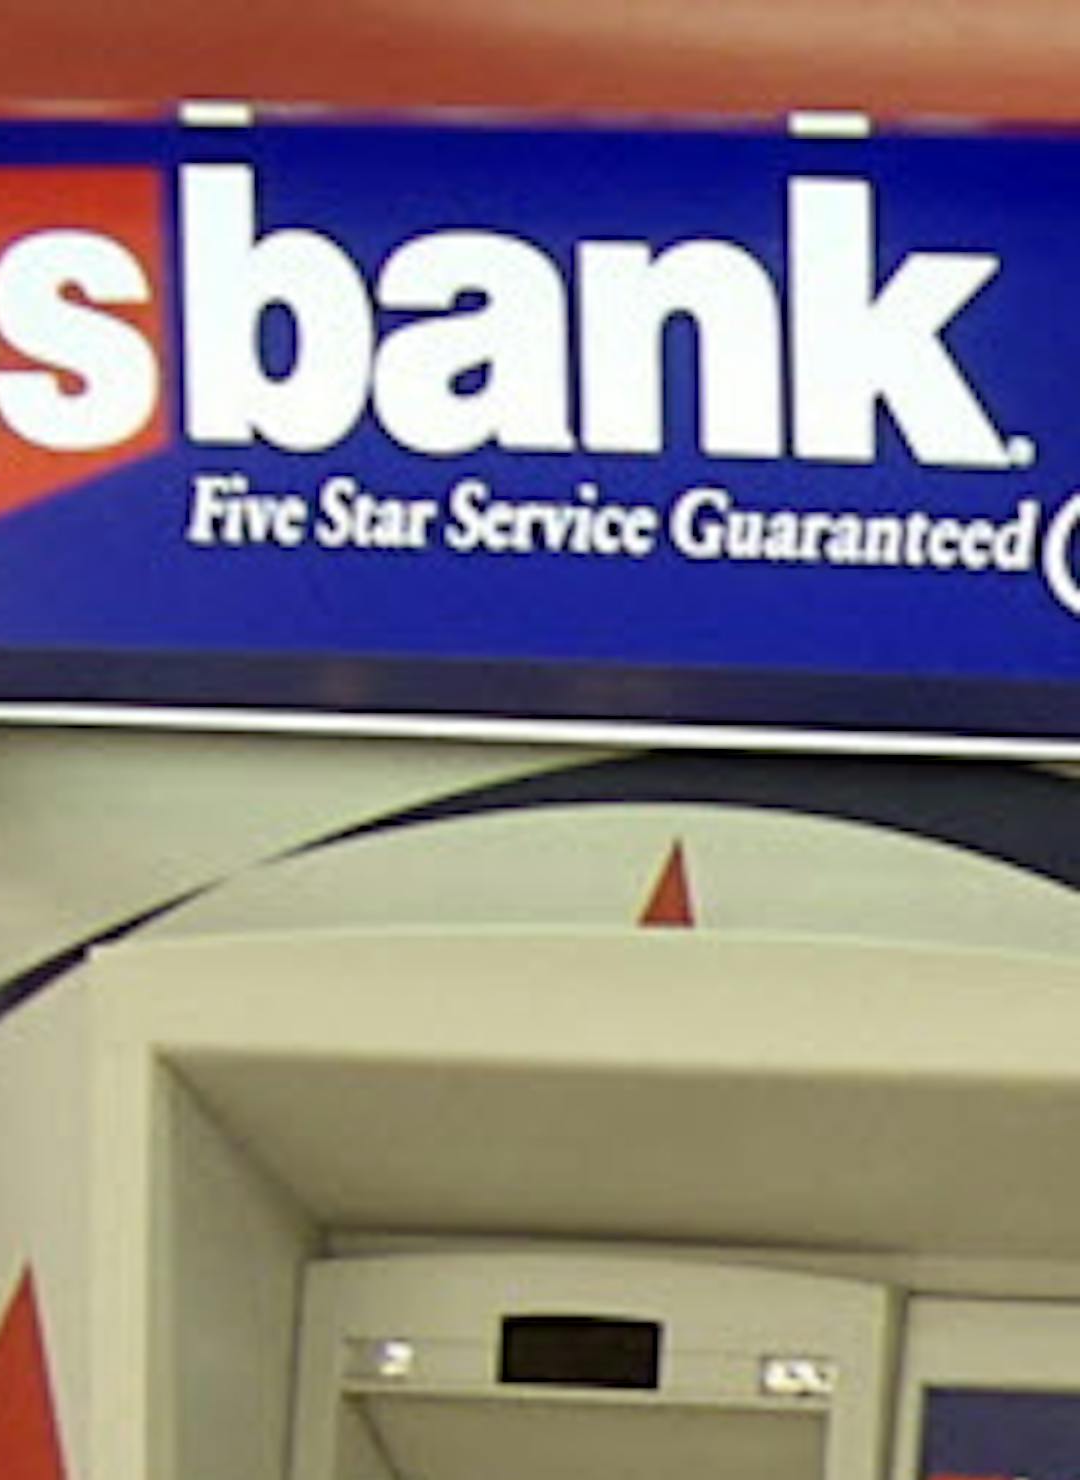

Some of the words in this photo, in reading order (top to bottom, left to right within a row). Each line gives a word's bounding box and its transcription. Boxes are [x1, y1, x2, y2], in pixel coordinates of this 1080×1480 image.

[187, 474, 308, 546] Five
[316, 475, 438, 548] Star
[445, 479, 659, 555] Service
[670, 487, 1040, 571] Guaranteed
